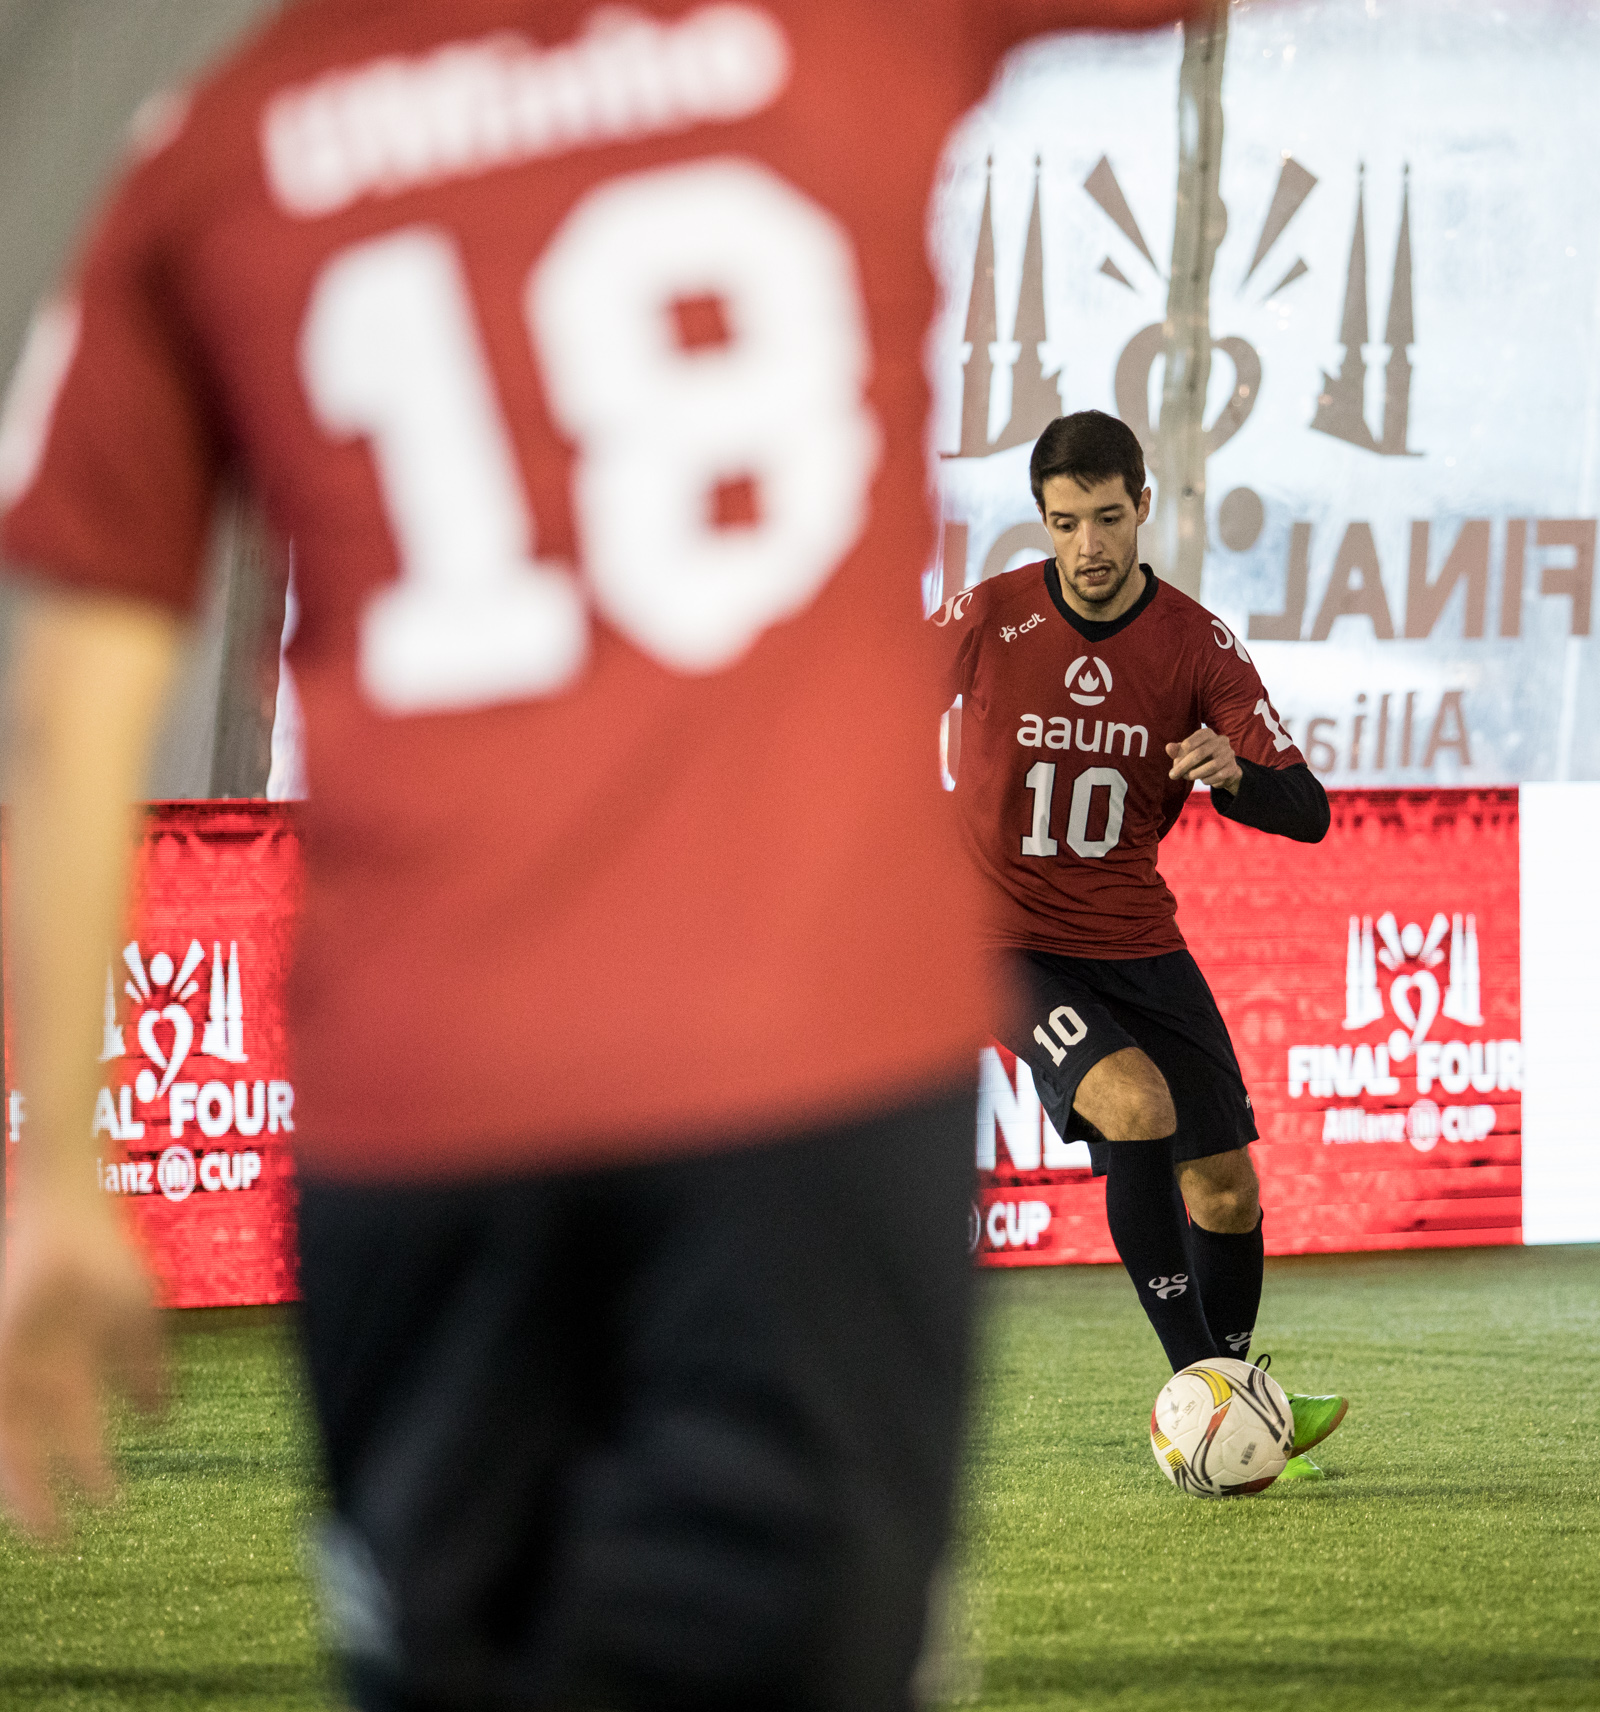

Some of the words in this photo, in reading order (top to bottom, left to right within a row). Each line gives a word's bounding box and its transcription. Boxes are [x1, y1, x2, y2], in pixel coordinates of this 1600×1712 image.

[300, 155, 882, 716] 18
[1019, 613, 1046, 634] cdt
[1016, 713, 1149, 758] aaum
[1021, 761, 1129, 858] 10
[1033, 1005, 1088, 1067] 10
[1288, 1043, 1400, 1098] FINAL
[1416, 1039, 1521, 1095] FOUR
[8, 1084, 145, 1143] FAL
[169, 1080, 295, 1138] FOUR
[1441, 1104, 1496, 1142] CUP
[199, 1151, 261, 1191] CUP
[986, 1200, 1052, 1247] CUP
